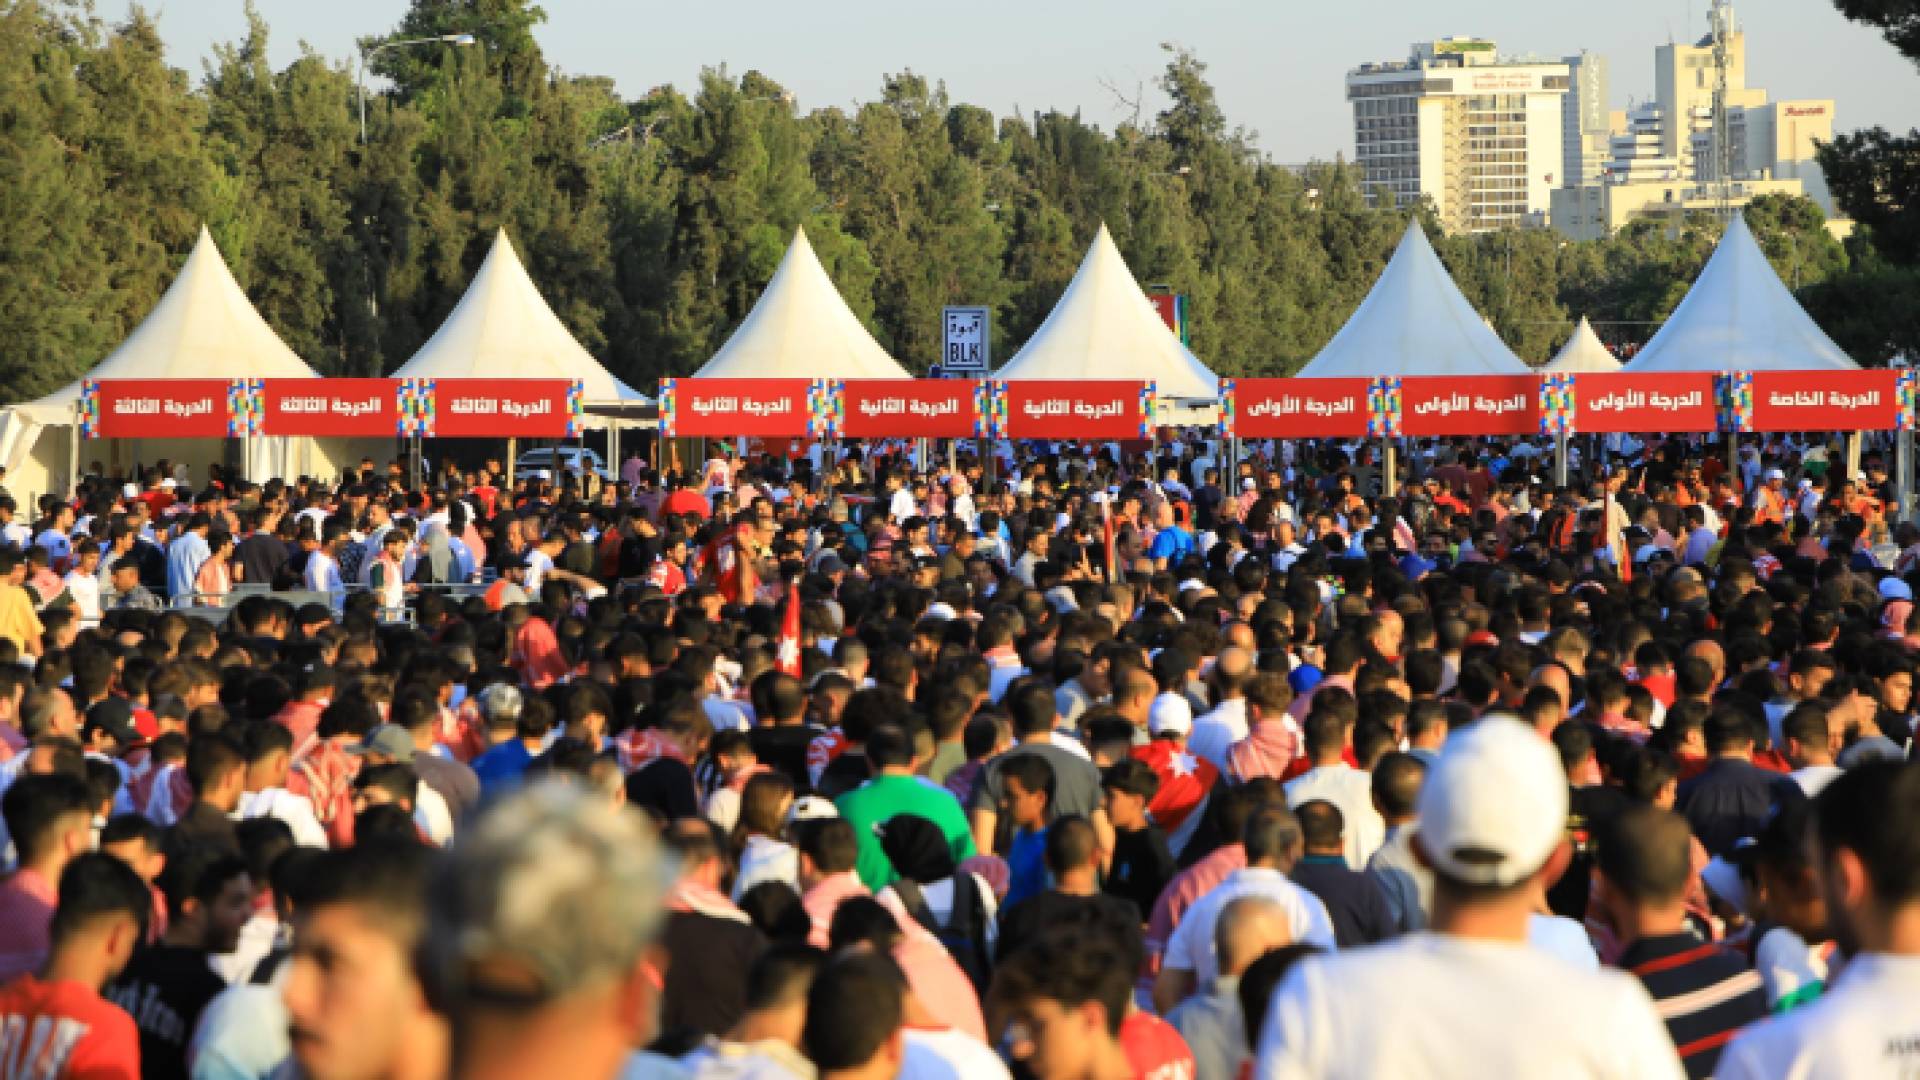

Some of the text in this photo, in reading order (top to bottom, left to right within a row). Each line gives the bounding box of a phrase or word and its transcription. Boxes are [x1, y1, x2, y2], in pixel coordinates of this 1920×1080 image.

[950, 342, 981, 362] BLK
[114, 397, 213, 417] الدرجة الثالثة
[280, 396, 381, 416] الدرجة الثالثة
[451, 397, 551, 418] الدرجة الثالثة
[691, 396, 791, 416] الدرجة الثانية
[860, 397, 958, 417] الدرجة الثانية
[1023, 399, 1123, 419] الدرجة الثانية
[1248, 395, 1353, 418] الدرجة الأولى
[1415, 392, 1526, 416] الدرجة الأولى
[1589, 389, 1702, 412] الدرجة الأولى
[1768, 391, 1879, 411] الدرجة الخاصة
